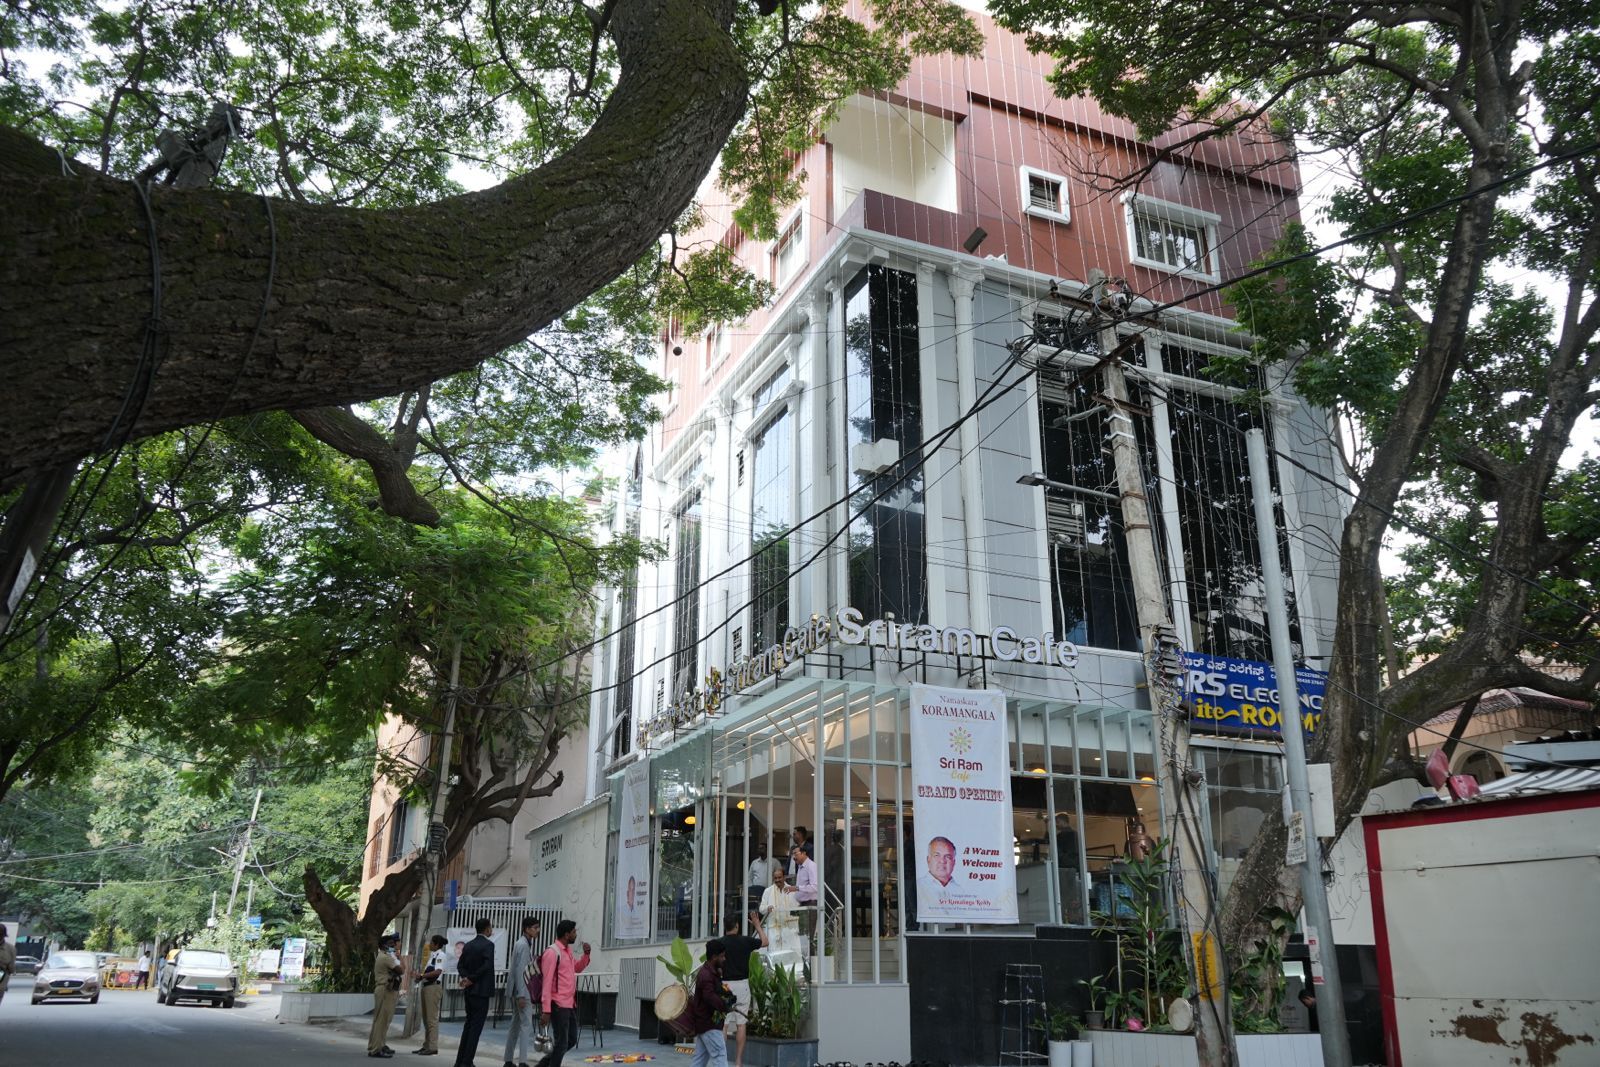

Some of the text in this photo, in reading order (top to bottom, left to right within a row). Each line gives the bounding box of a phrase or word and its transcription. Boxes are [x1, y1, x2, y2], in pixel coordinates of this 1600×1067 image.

[836, 607, 1079, 668] Sriram Cafe
[726, 613, 830, 695] Sriram Cafe
[940, 695, 978, 706] Namaskara
[921, 704, 996, 721] KORAMANGALA
[939, 757, 983, 771] Sri Ram
[918, 785, 957, 799] GRAND
[963, 847, 1000, 856] A Warm
[962, 859, 1003, 868] Welcome
[968, 871, 996, 881] to you
